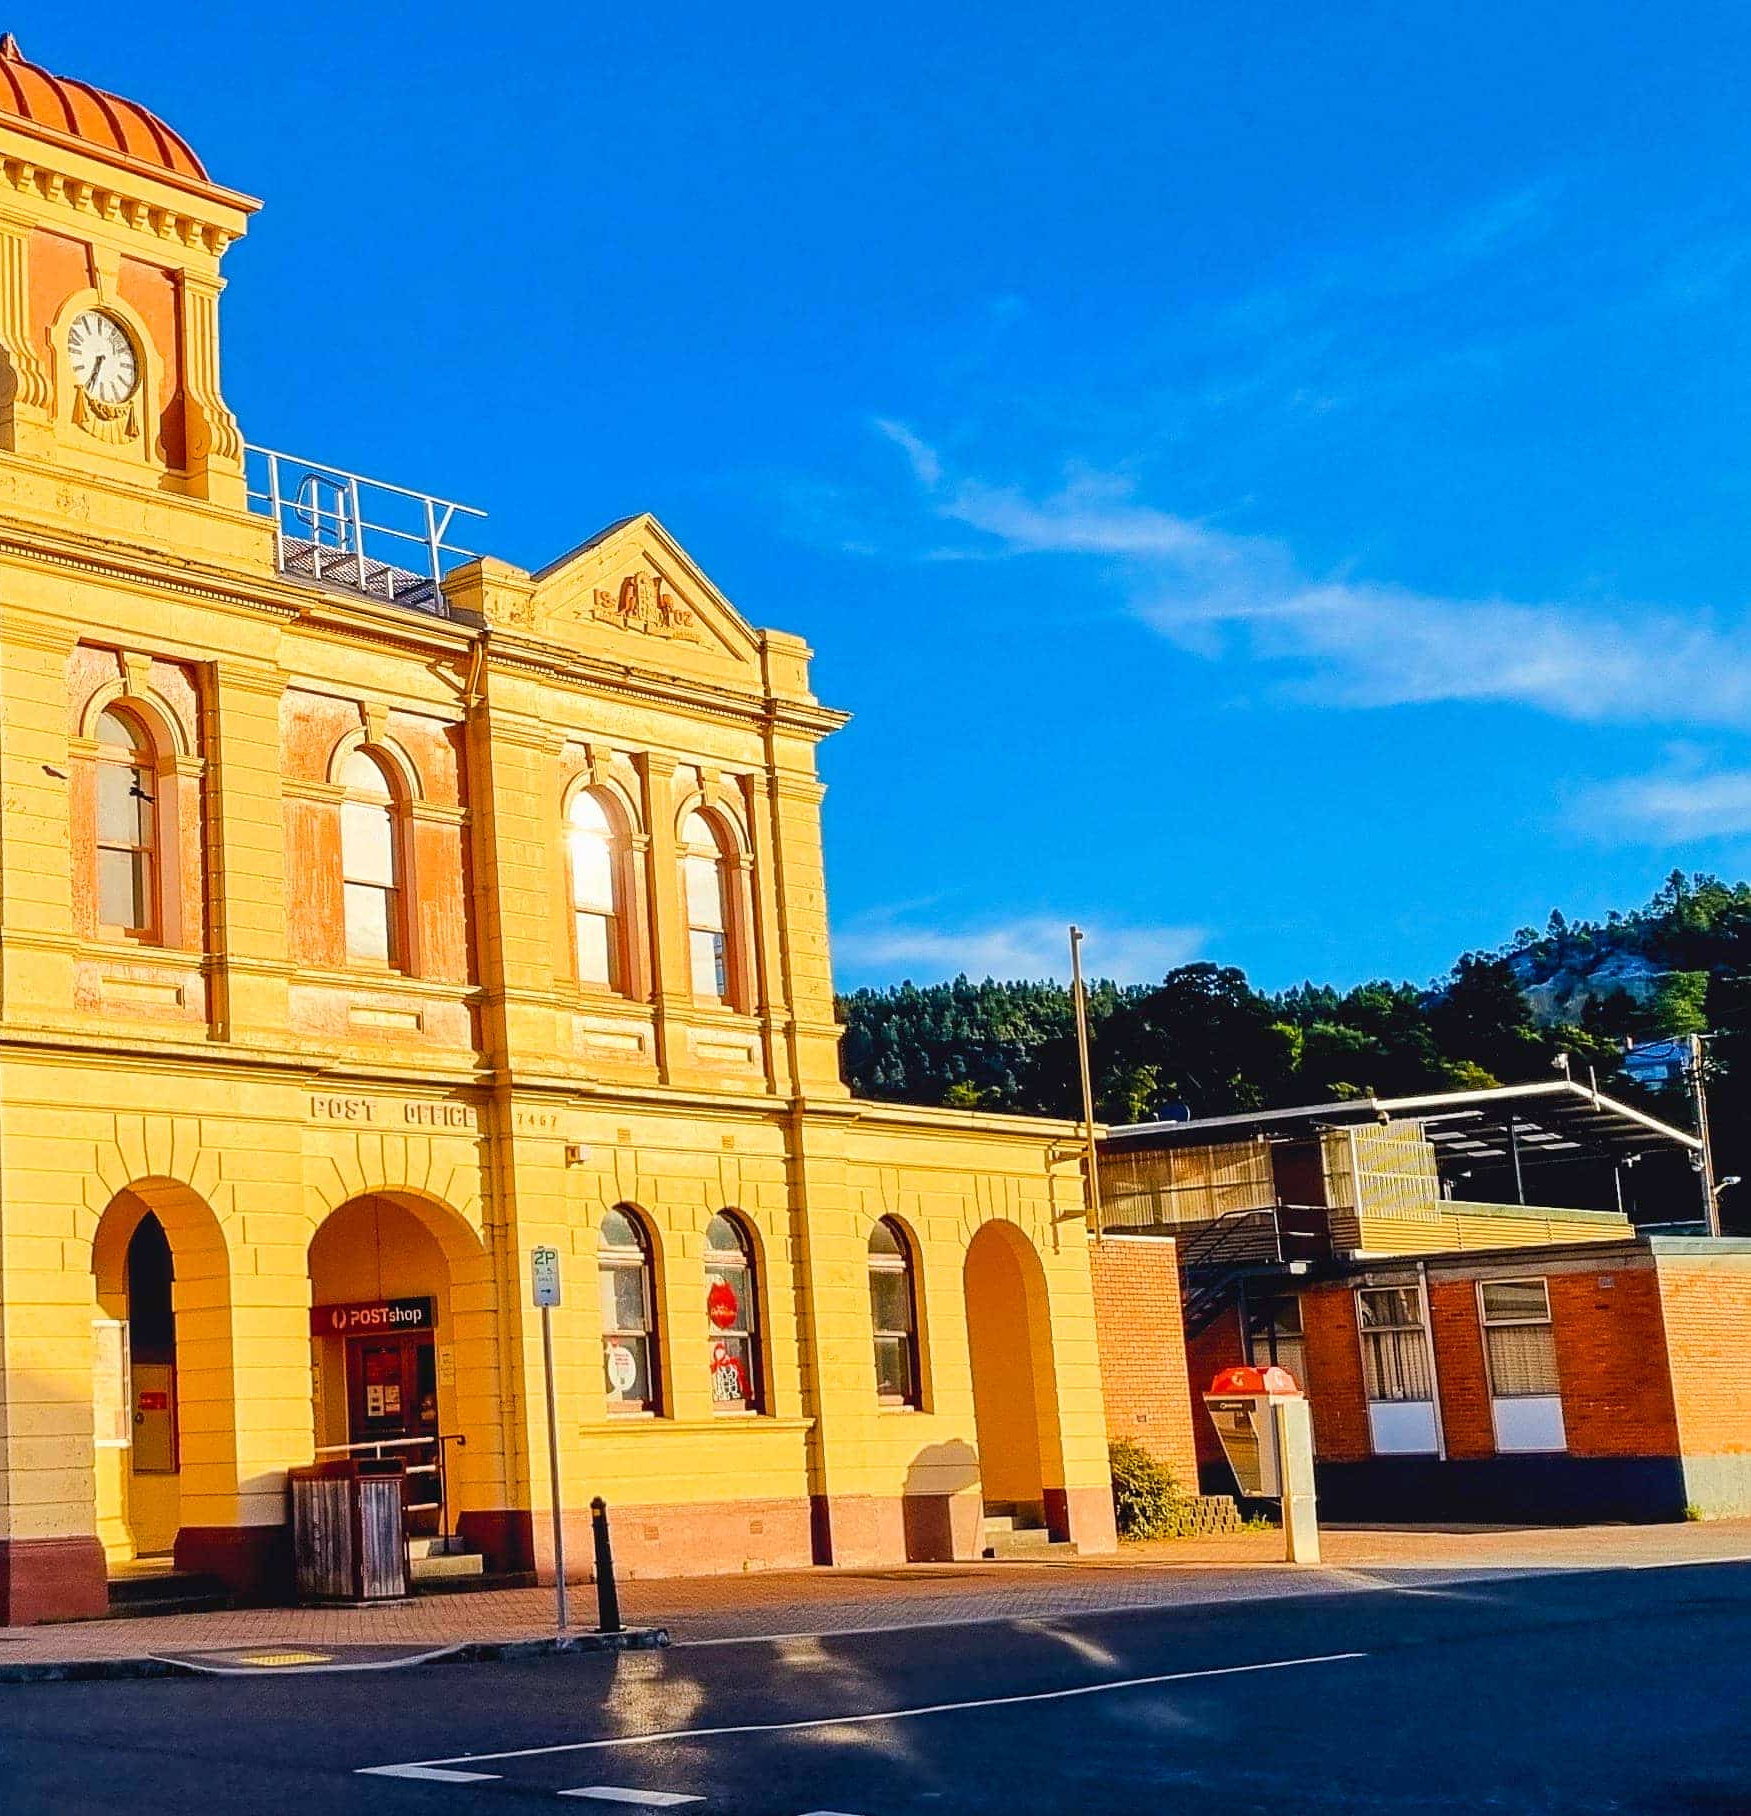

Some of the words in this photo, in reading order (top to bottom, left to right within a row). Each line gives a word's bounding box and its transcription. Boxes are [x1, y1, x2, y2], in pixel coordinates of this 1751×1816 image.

[311, 1096, 376, 1121] POST
[404, 1102, 477, 1128] OFFICE
[534, 1251, 555, 1265] 2P
[350, 1306, 422, 1325] POSTshop
